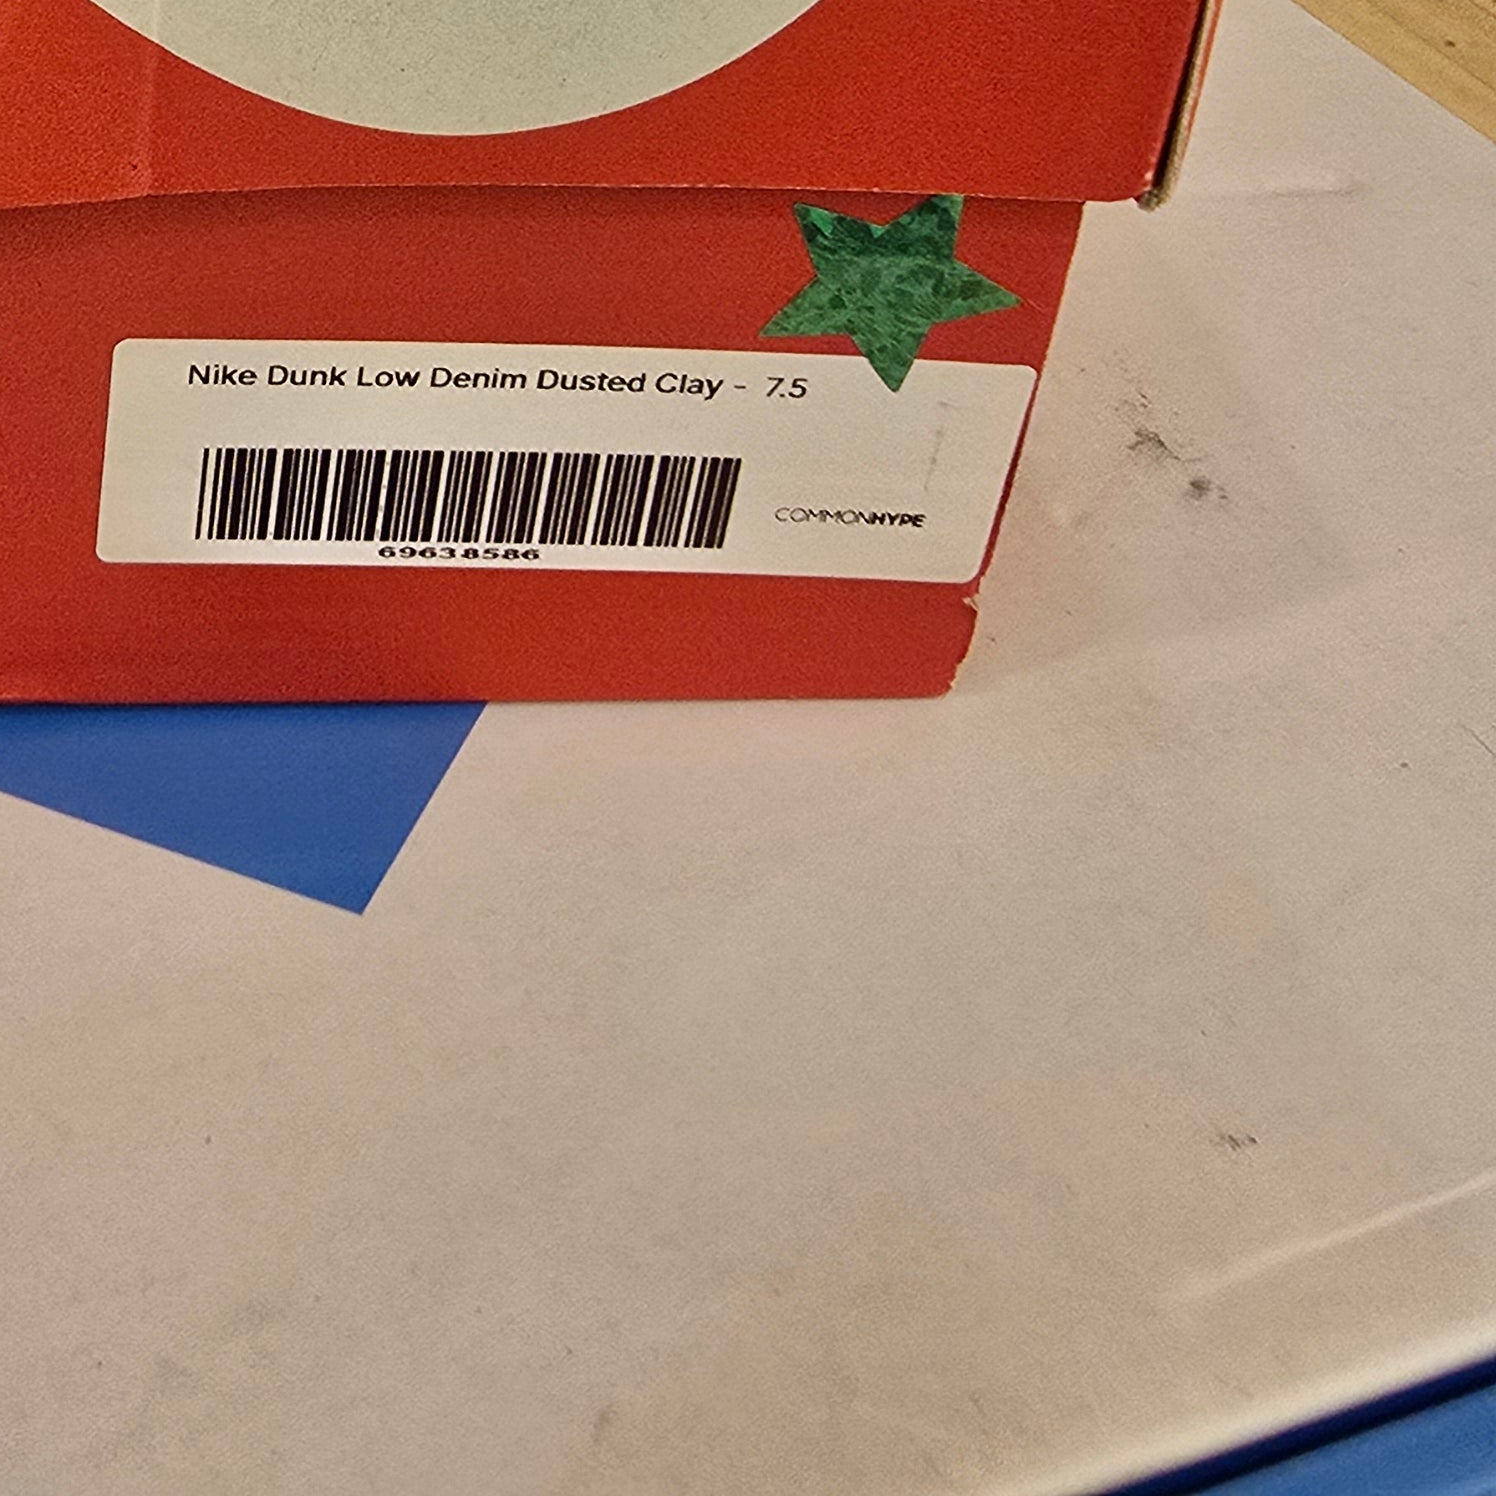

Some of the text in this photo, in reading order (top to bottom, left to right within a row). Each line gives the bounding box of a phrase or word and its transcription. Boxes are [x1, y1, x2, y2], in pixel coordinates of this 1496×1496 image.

[188, 363, 258, 387] Nike
[267, 364, 348, 387] Dunk
[356, 365, 421, 388] Low
[429, 366, 527, 389] Denim
[536, 369, 647, 393] Dusted
[655, 372, 724, 401] Clay
[765, 376, 809, 400] 7.5
[775, 507, 928, 529] COMMONHYPE
[378, 545, 541, 561] 69638586
